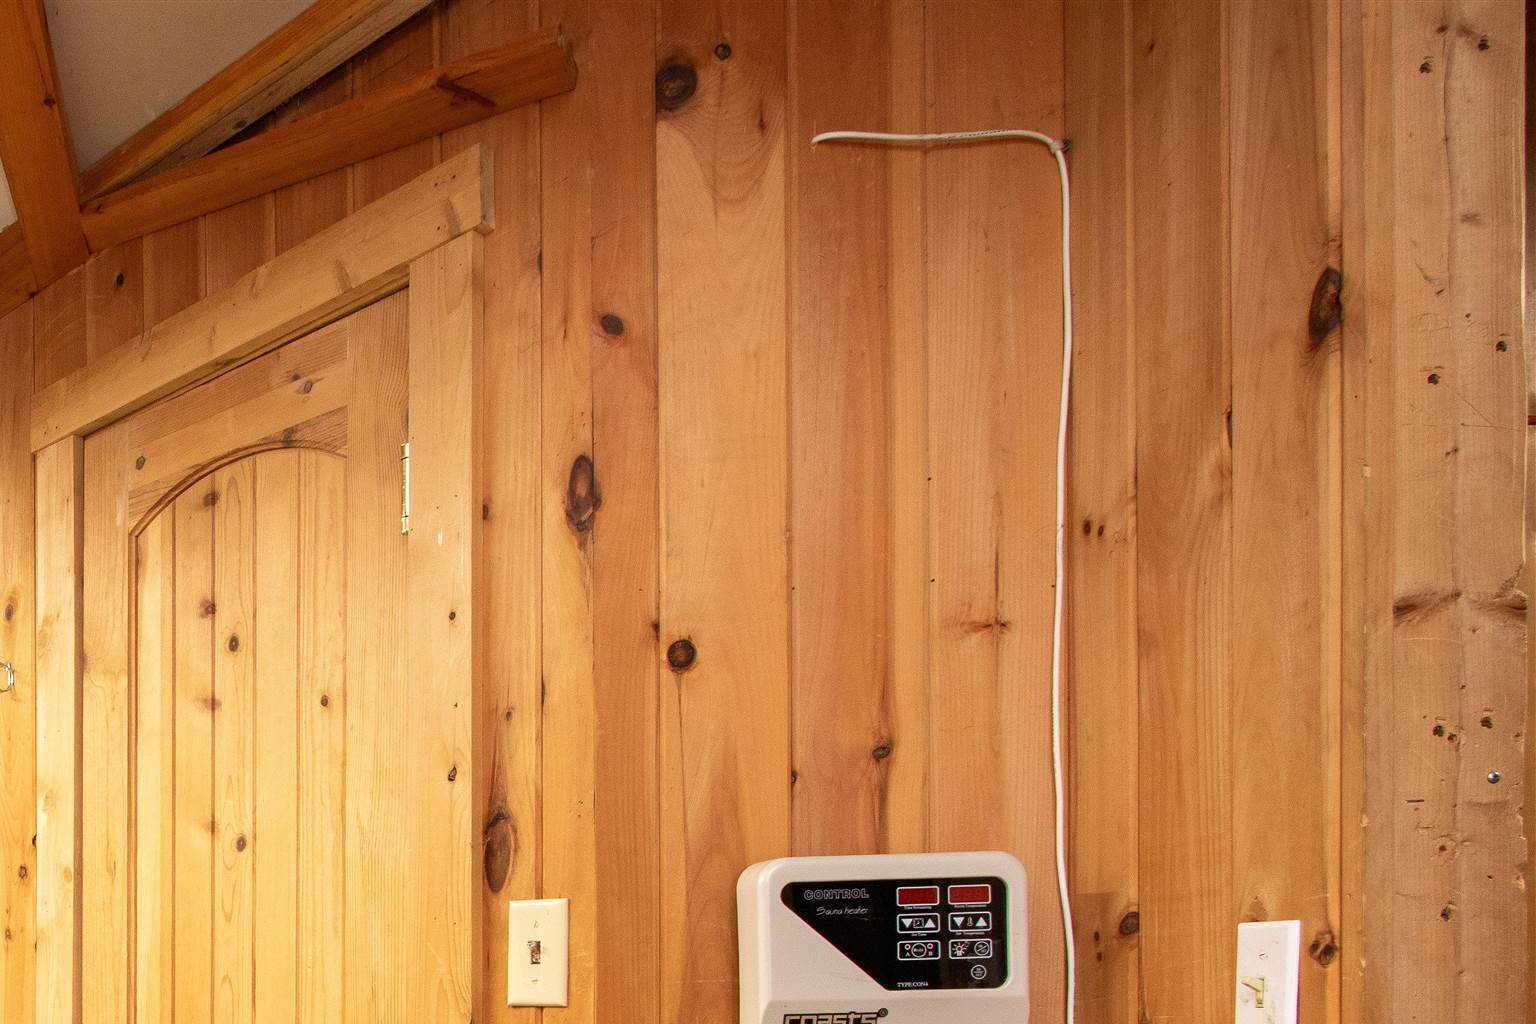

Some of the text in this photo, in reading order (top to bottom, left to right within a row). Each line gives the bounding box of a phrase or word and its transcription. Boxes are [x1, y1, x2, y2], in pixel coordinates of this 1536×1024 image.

[803, 888, 870, 901] CONTROL
[815, 905, 869, 916] Sauna heater
